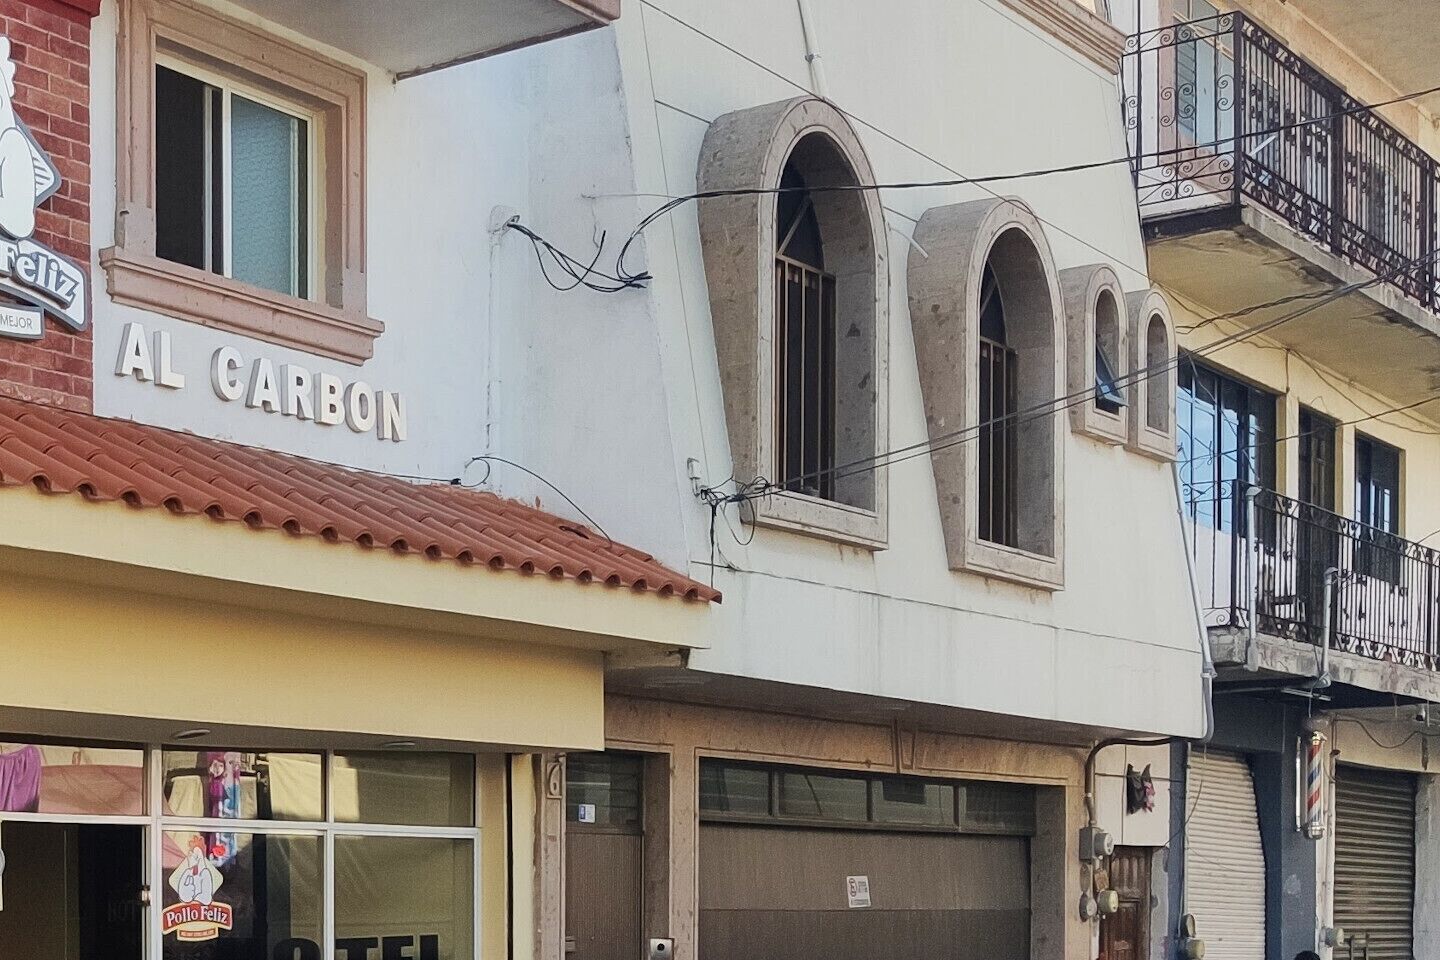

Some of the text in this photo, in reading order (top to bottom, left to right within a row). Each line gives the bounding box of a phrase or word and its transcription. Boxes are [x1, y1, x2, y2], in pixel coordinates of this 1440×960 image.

[0, 313, 33, 330] MEJOR
[114, 321, 408, 443] AL CARBON
[166, 905, 229, 928] Pollo Feliz
